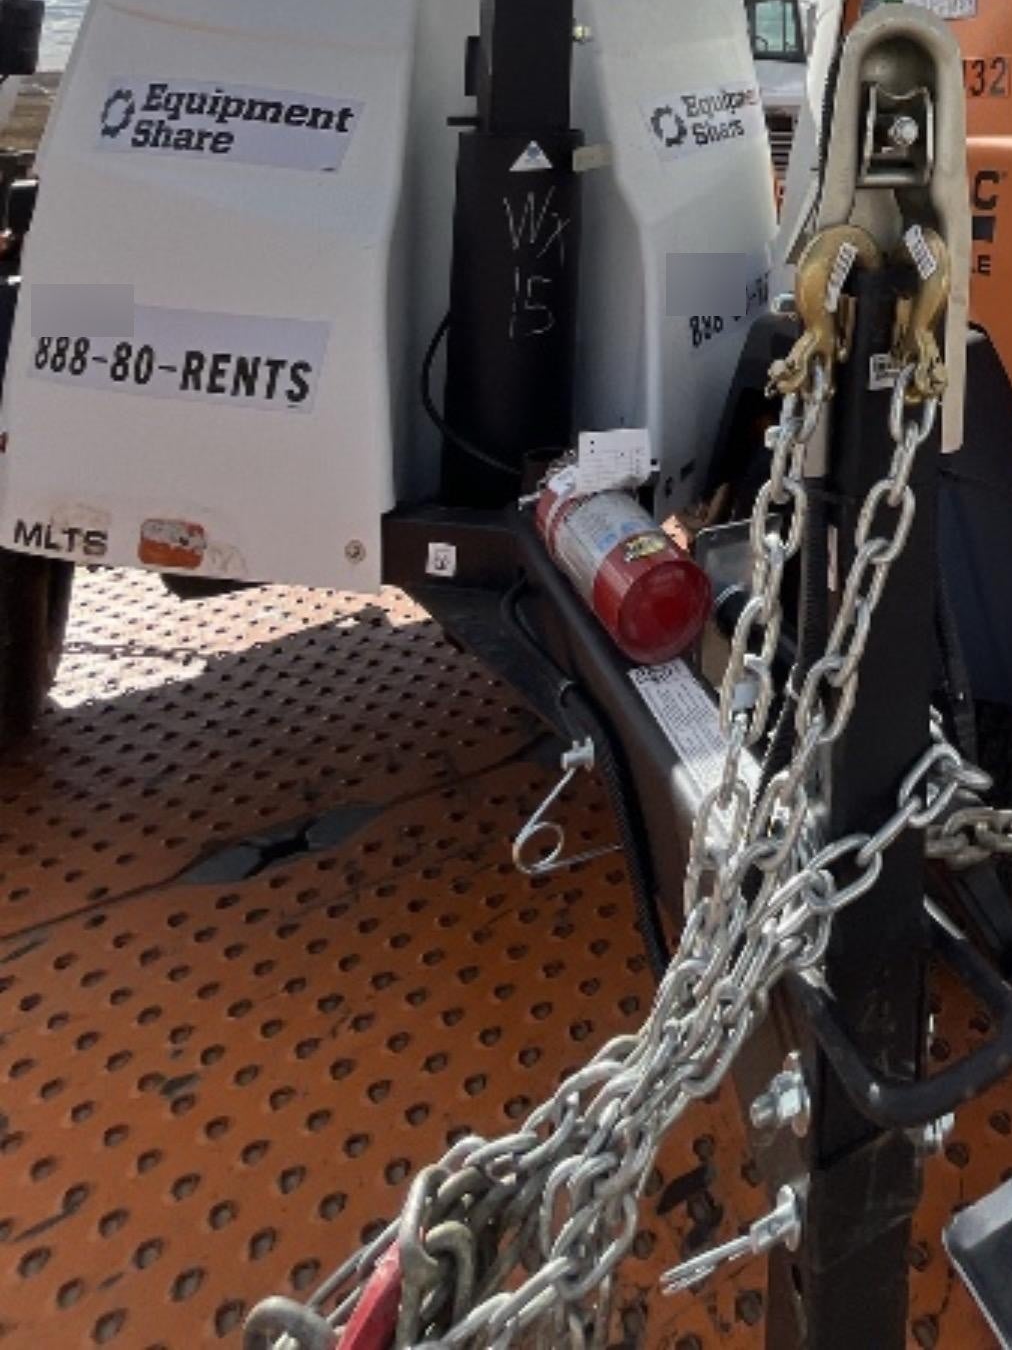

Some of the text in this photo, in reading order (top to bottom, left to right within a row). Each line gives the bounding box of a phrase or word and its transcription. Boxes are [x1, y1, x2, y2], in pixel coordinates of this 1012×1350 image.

[141, 83, 355, 132] Equipment
[131, 119, 234, 154] Share
[34, 337, 313, 403] 888-80-RENTS
[13, 518, 108, 556] MLTS
